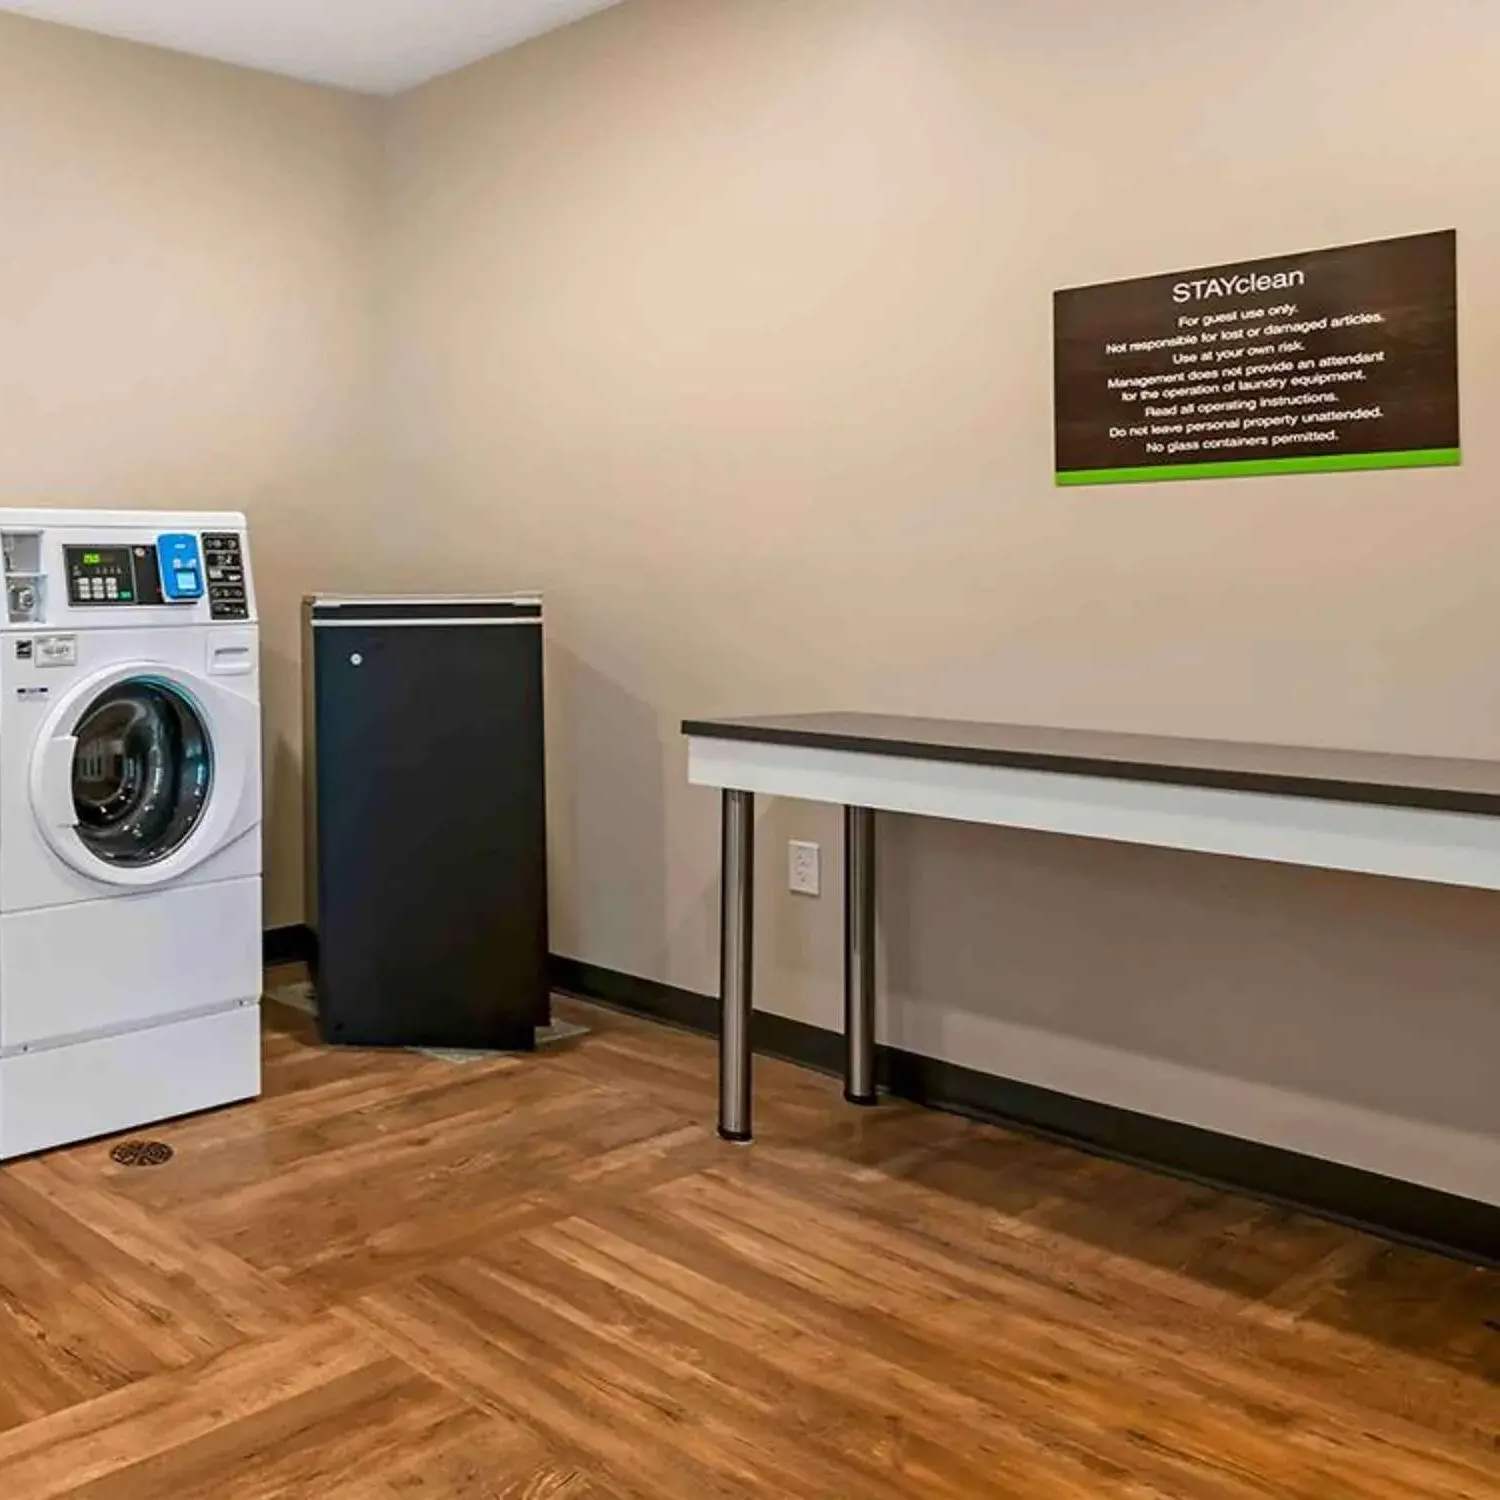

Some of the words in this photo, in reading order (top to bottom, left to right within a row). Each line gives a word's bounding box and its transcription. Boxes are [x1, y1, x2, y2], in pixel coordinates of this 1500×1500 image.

[1172, 270, 1305, 303] STAYclean
[1178, 316, 1200, 328] For
[1202, 311, 1237, 327] guest
[1240, 308, 1265, 320] use
[1267, 303, 1298, 317] only.
[1106, 343, 1127, 354] Not
[1129, 334, 1198, 351] responsible
[1201, 332, 1218, 343] for
[1221, 329, 1244, 341] lost
[1246, 327, 1261, 338] or
[1263, 317, 1327, 335] damaged
[1330, 313, 1384, 328] articles.
[1172, 353, 1198, 365] Use
[1200, 351, 1213, 361] at
[1215, 348, 1245, 362] your
[1246, 345, 1275, 356] own
[1278, 340, 1305, 352] risk.
[1107, 372, 1185, 388] Management
[1187, 369, 1219, 381] does
[1221, 366, 1243, 377] not
[1245, 361, 1294, 377] provide
[1297, 359, 1315, 370] an
[1318, 351, 1384, 367] attendant
[1121, 392, 1138, 401] for
[1140, 390, 1159, 400] the
[1162, 385, 1220, 399] operation
[1222, 381, 1235, 392] of
[1238, 377, 1287, 391] laundry
[1290, 369, 1366, 387] equipment.
[1145, 405, 1178, 417] Read
[1180, 403, 1195, 415] all
[1197, 399, 1257, 414] operating
[1259, 392, 1338, 407] instructions.
[1109, 427, 1127, 438] Do
[1129, 426, 1148, 436] not
[1151, 424, 1183, 435] leave
[1185, 418, 1240, 434] personal
[1243, 414, 1299, 430] property
[1301, 407, 1383, 423] unattended.
[1146, 442, 1165, 453] No
[1167, 441, 1200, 453] glass
[1202, 436, 1269, 449] containers
[1271, 429, 1338, 446] permitted.
